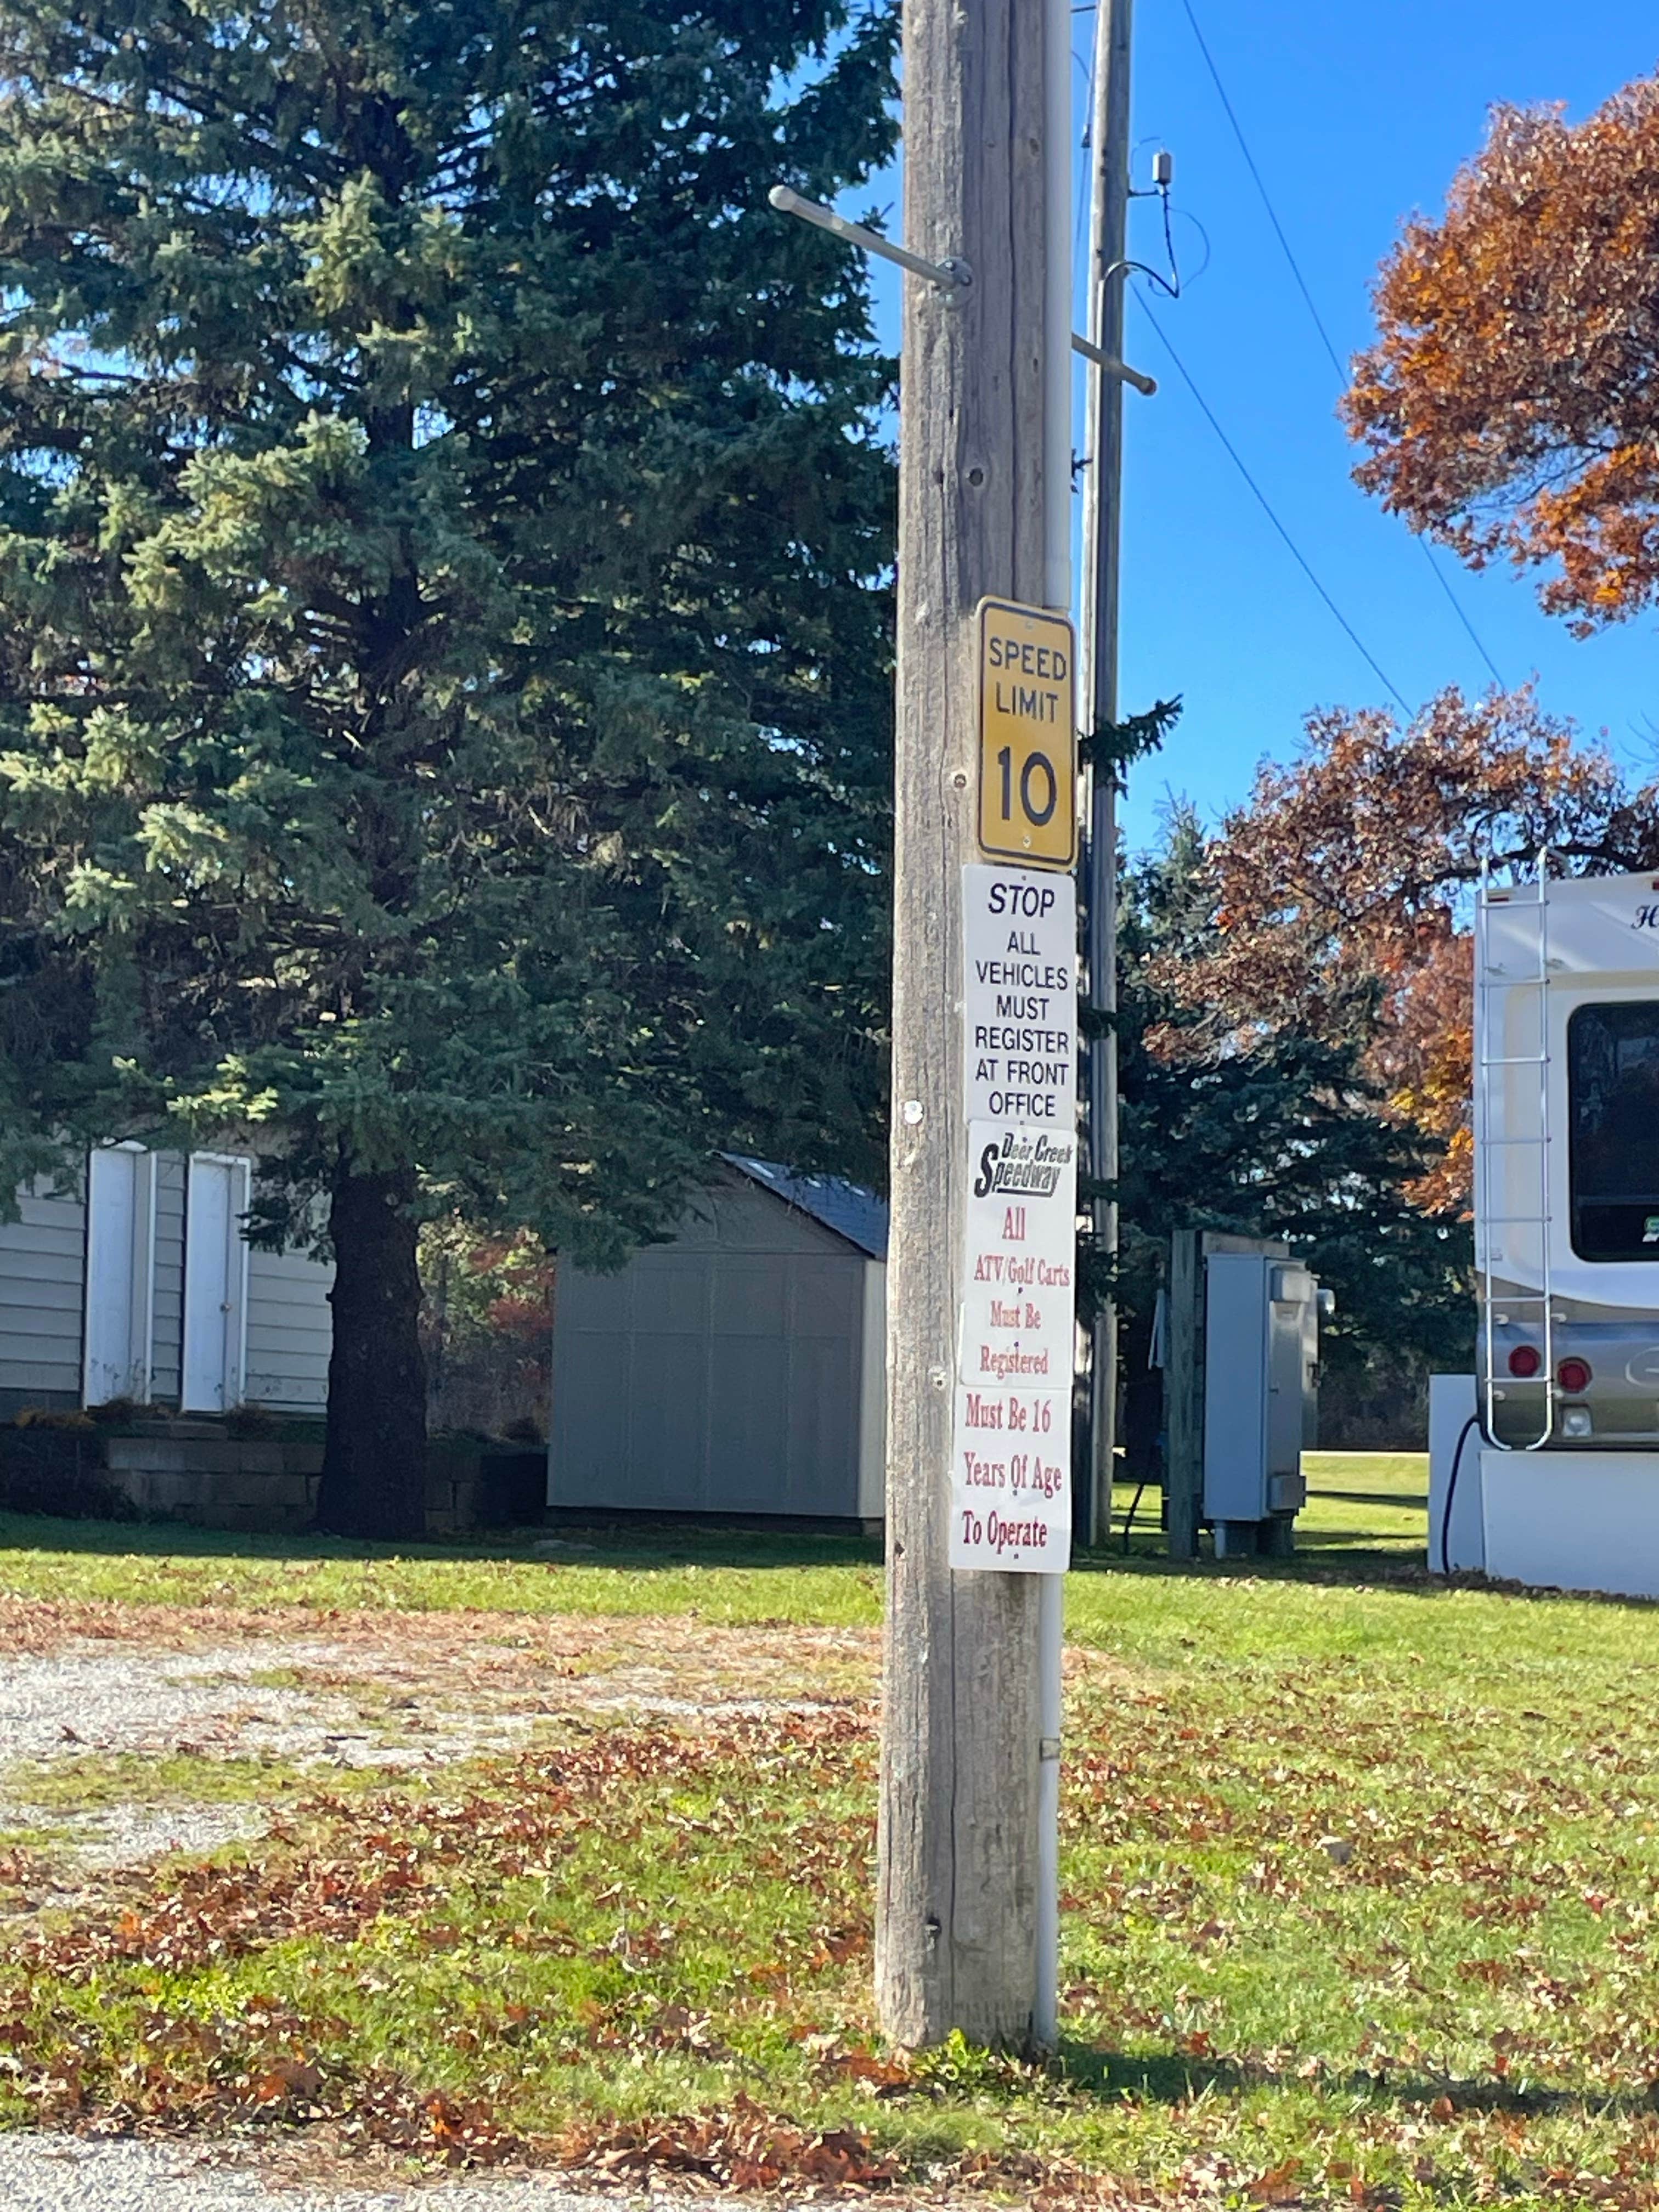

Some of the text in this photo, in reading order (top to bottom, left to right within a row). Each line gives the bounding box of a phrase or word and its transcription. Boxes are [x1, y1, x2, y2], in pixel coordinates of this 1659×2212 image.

[990, 637, 1066, 680] SPEED
[996, 681, 1058, 723] LIMIT
[998, 746, 1057, 826] 10
[989, 883, 1054, 917] STOP
[1007, 931, 1041, 955] ALL
[975, 960, 1068, 990] VEHICLES
[996, 995, 1049, 1020] MUST
[975, 1026, 1068, 1054] REGISTER
[975, 1059, 1069, 1085] AT FRONT
[989, 1091, 1055, 1117] OFFICE
[1002, 1132, 1073, 1164] Deer Creek
[974, 1143, 1061, 1198] Speedway
[1002, 1206, 1025, 1240] All
[974, 1254, 1070, 1286] ATV/Golf Carts
[990, 1300, 1041, 1329] Must Be
[980, 1345, 1048, 1379] Registered
[966, 1393, 1051, 1432] Must Be 16
[964, 1452, 1062, 1498] Years Of Age
[962, 1510, 1047, 1554] To Operate
